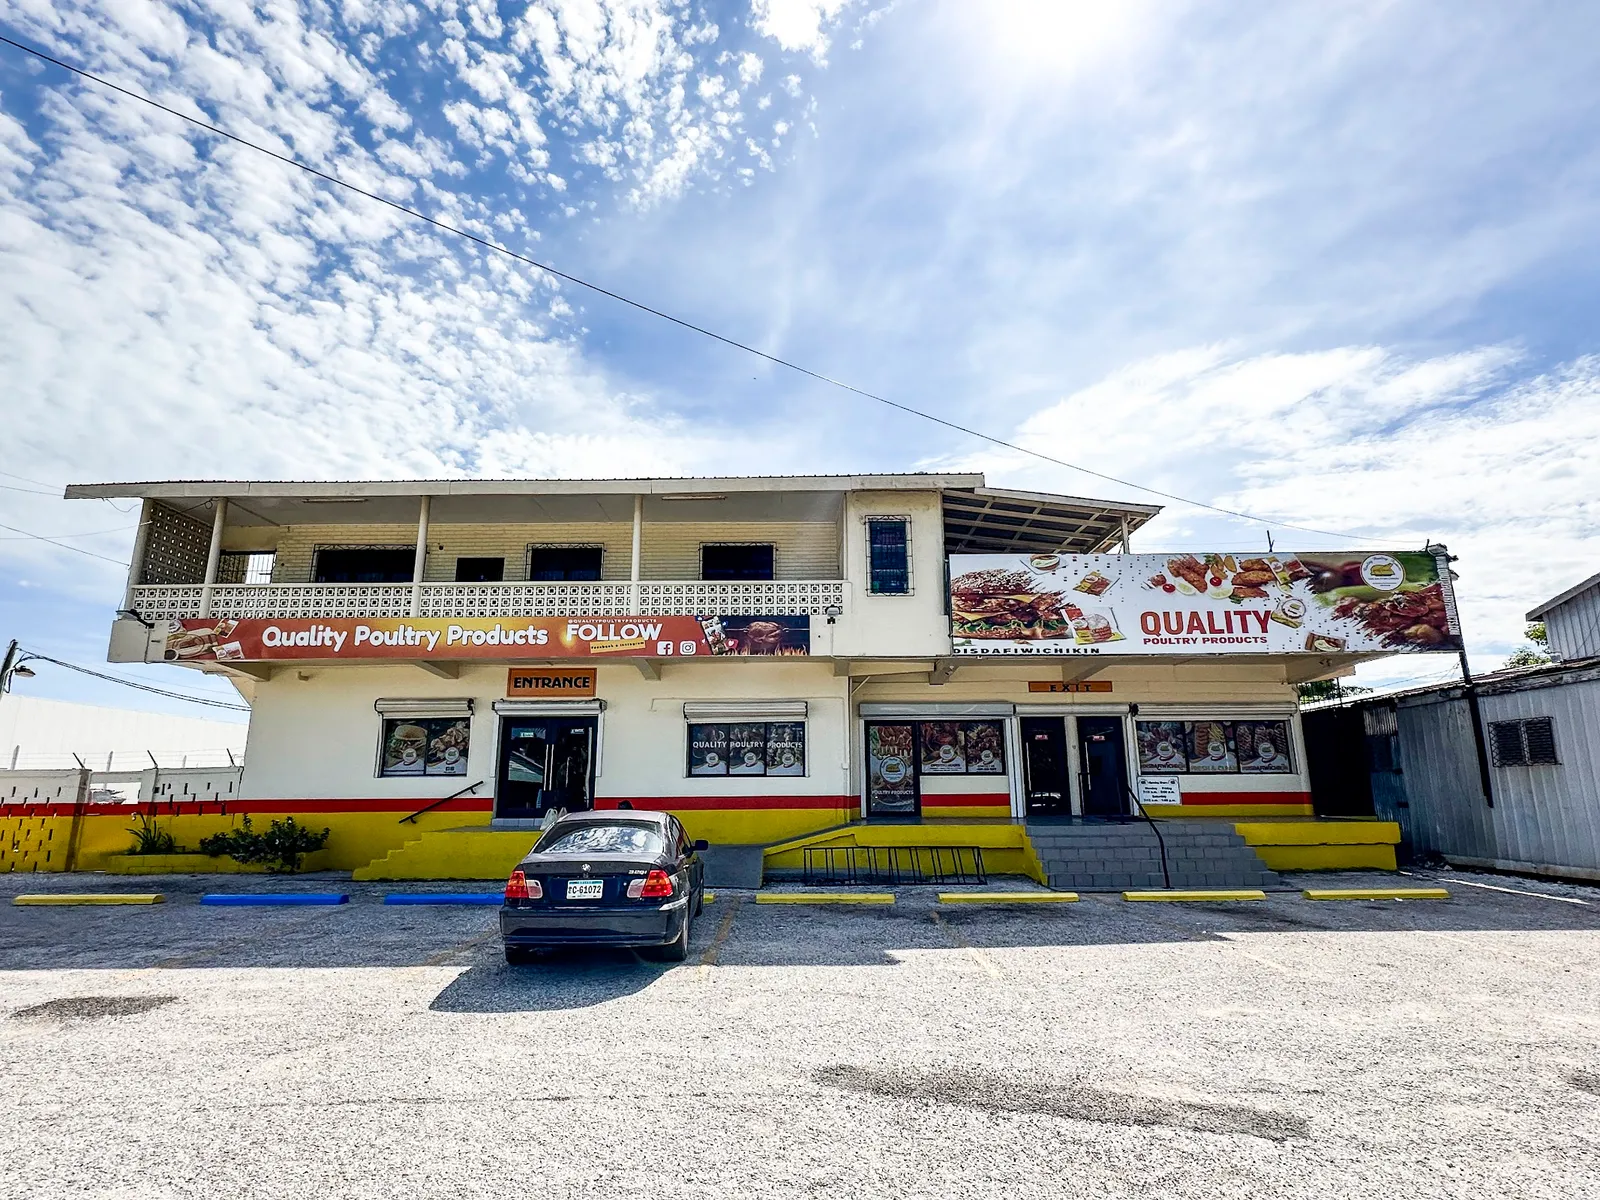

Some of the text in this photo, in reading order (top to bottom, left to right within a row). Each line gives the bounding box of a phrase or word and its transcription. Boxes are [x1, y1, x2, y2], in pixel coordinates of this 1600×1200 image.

[1140, 610, 1271, 637] QUALITY
[262, 623, 549, 653] Quality Poultry Products
[566, 623, 662, 641] FOLLOW
[1143, 636, 1268, 645] POULTRY PRODUCTS
[513, 676, 591, 689] ENTRANCE
[1050, 684, 1092, 692] EXIT
[692, 741, 727, 749] QUALITY
